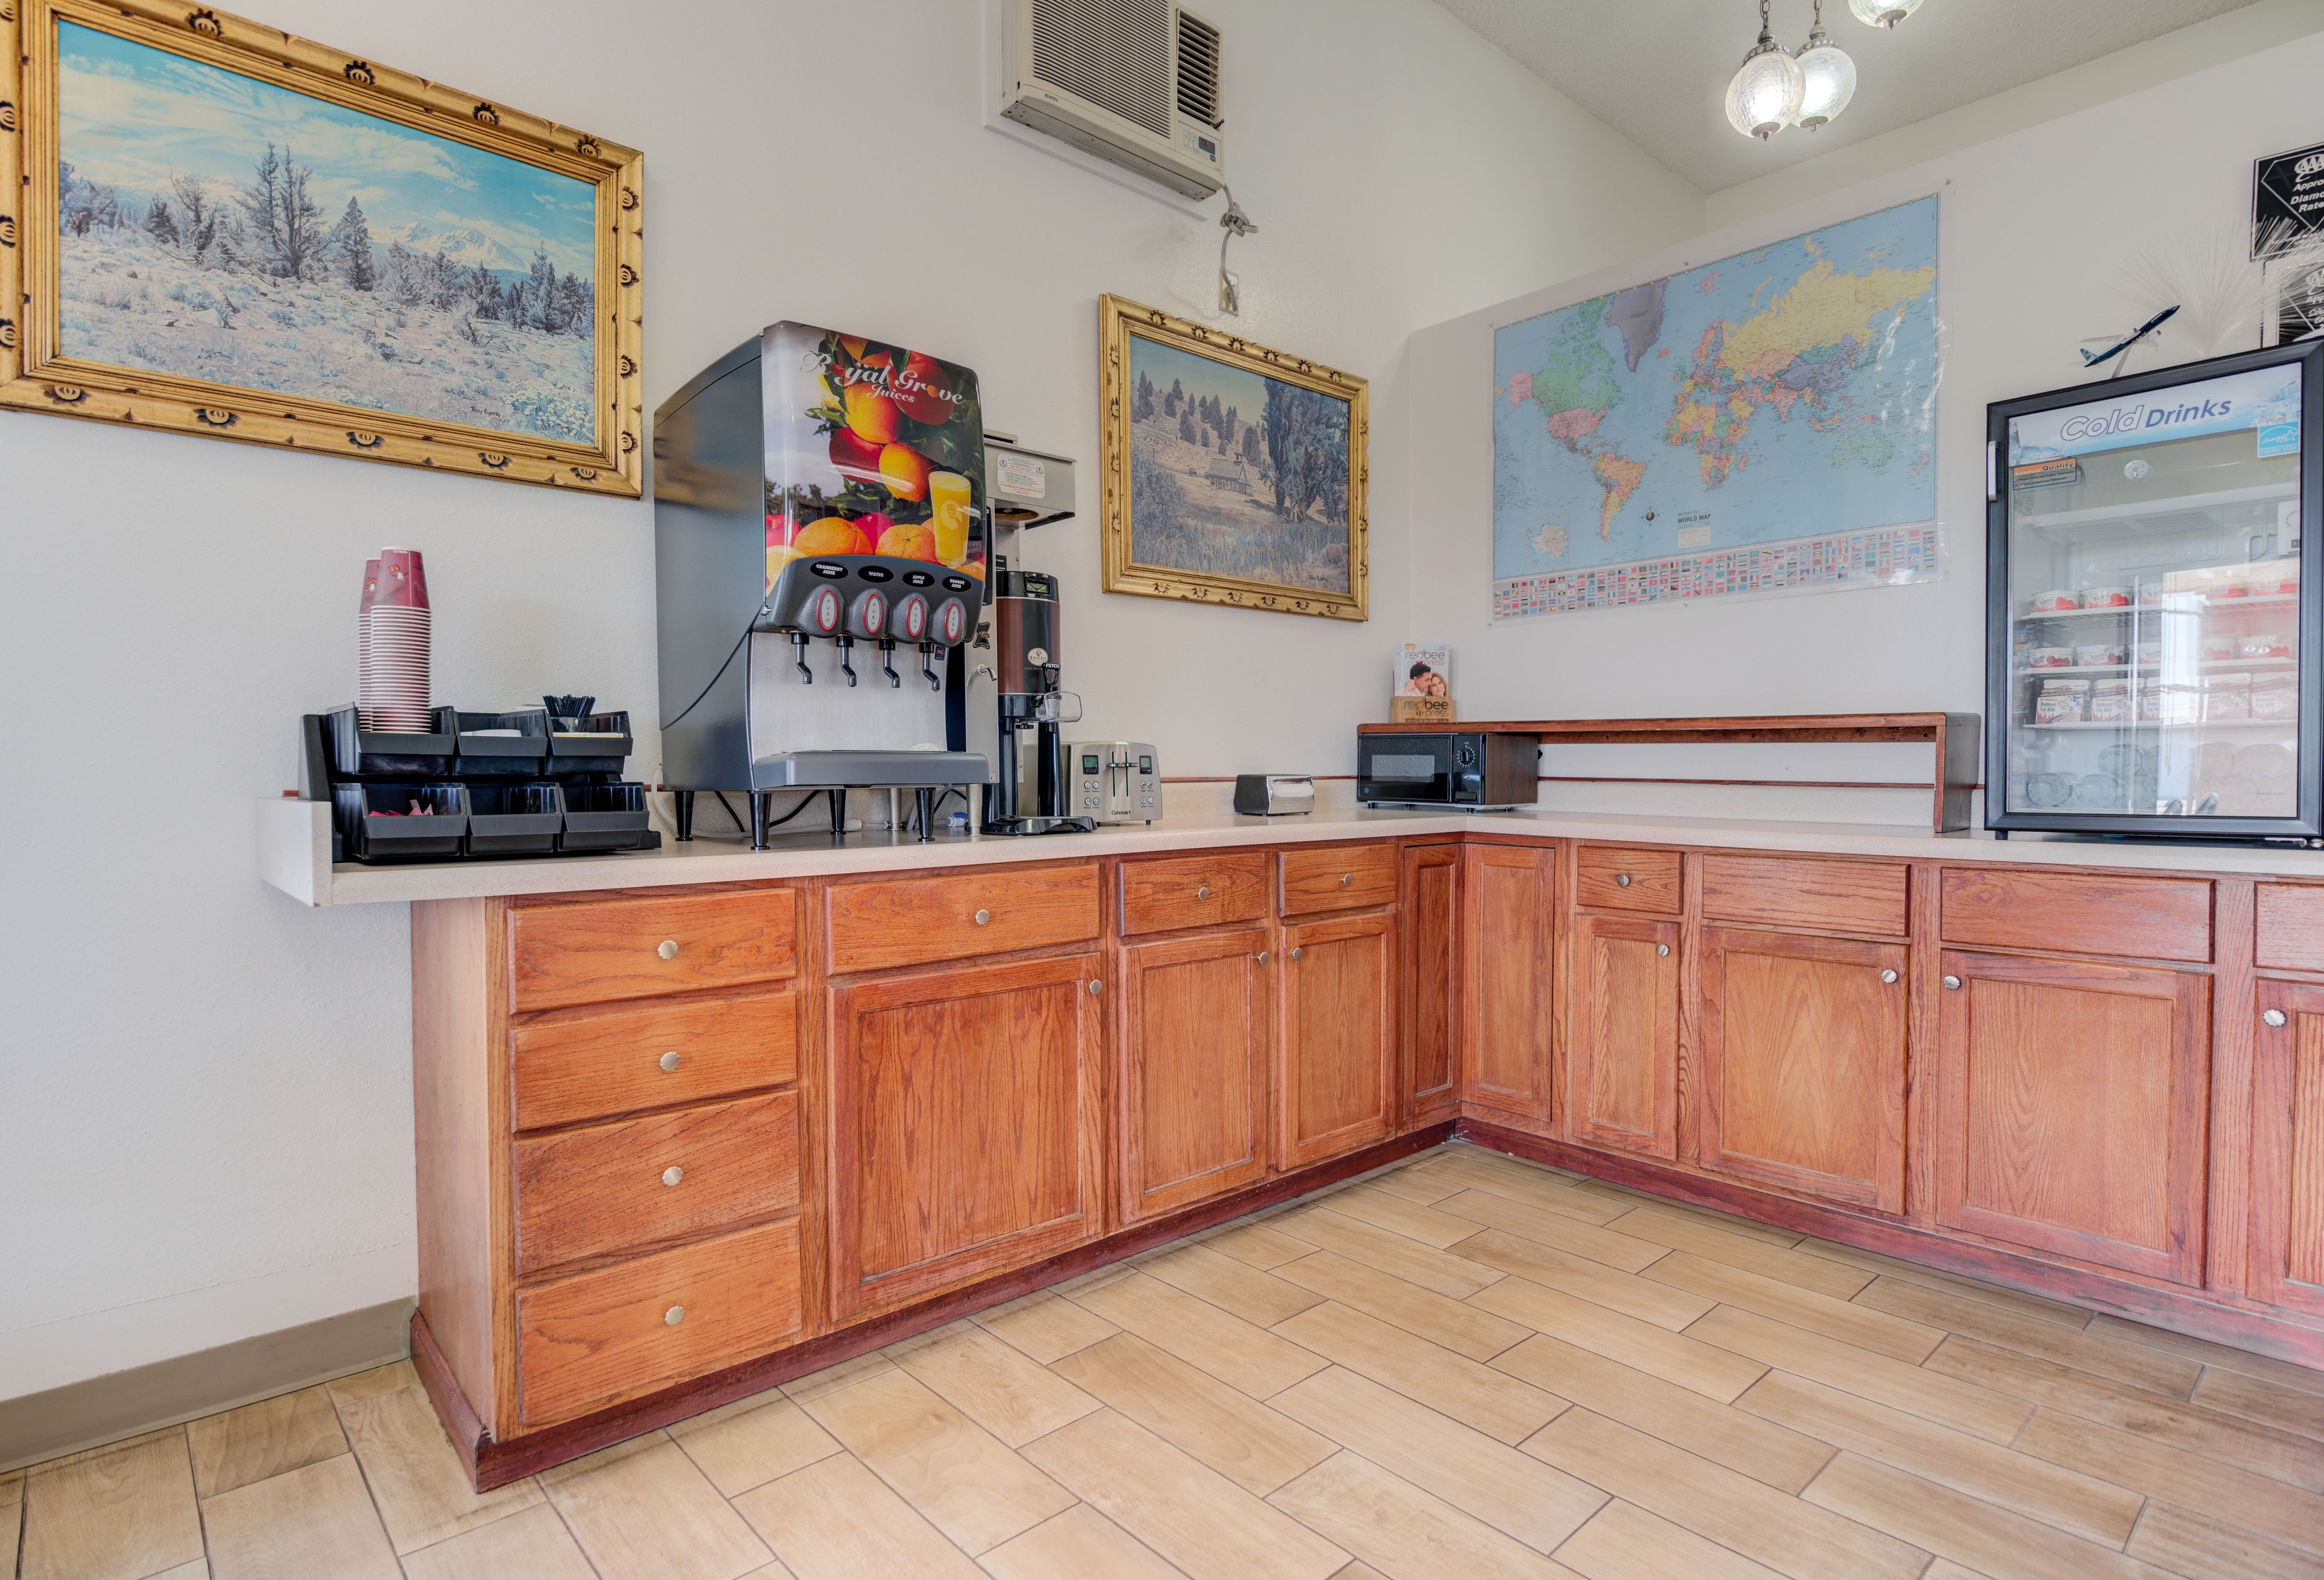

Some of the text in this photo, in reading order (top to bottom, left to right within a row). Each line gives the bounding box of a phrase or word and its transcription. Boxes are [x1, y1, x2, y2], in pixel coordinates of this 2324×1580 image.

[799, 351, 966, 405] Royal Grove
[866, 384, 916, 403] Juices
[2060, 399, 2232, 441] Cold Drinks
[2042, 462, 2073, 471] Quality
[2040, 597, 2054, 606] Yami
[2093, 593, 2110, 602] Yami
[1405, 649, 1445, 660] redbee
[2090, 652, 2107, 660] Yami
[1403, 698, 1448, 710] redbee
